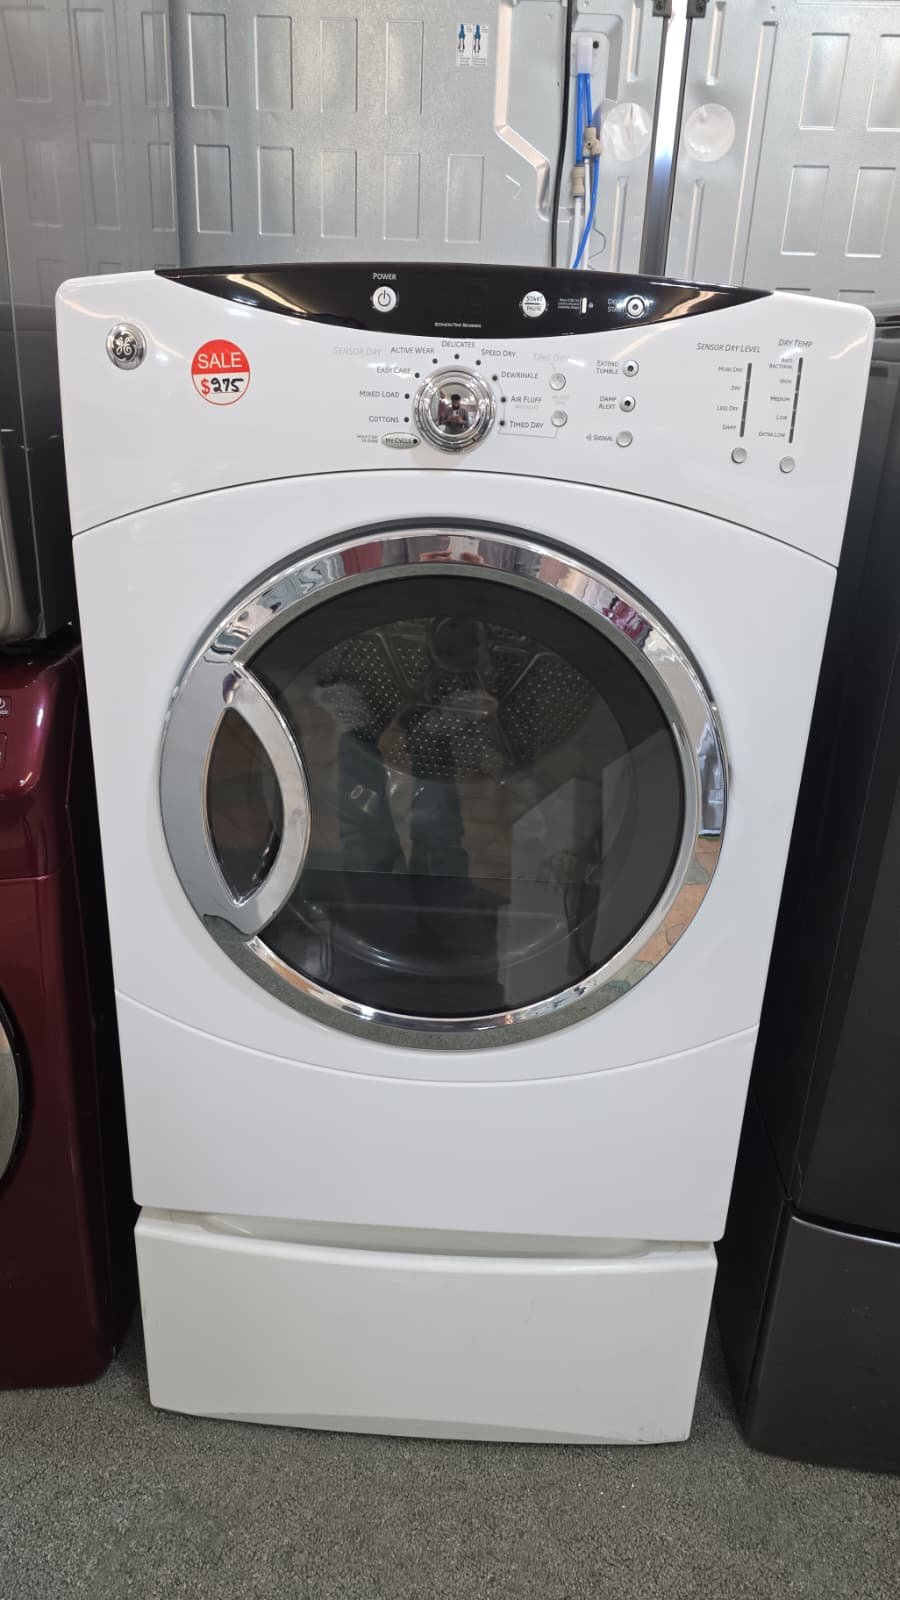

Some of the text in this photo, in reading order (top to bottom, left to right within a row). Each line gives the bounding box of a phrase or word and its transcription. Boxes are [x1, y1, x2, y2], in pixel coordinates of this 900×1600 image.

[696, 342, 761, 353] SENSOR DRY LEVEL
[778, 339, 813, 348] DRY TEMP
[390, 346, 414, 354] ACTIVE
[480, 349, 517, 358] SPEED DRY
[197, 352, 243, 369] SALE
[200, 377, 244, 395] $275
[359, 390, 381, 398] MIXED
[511, 395, 522, 403] AIR
[368, 416, 399, 424] COTTONS
[510, 420, 544, 429] TIMED DRY
